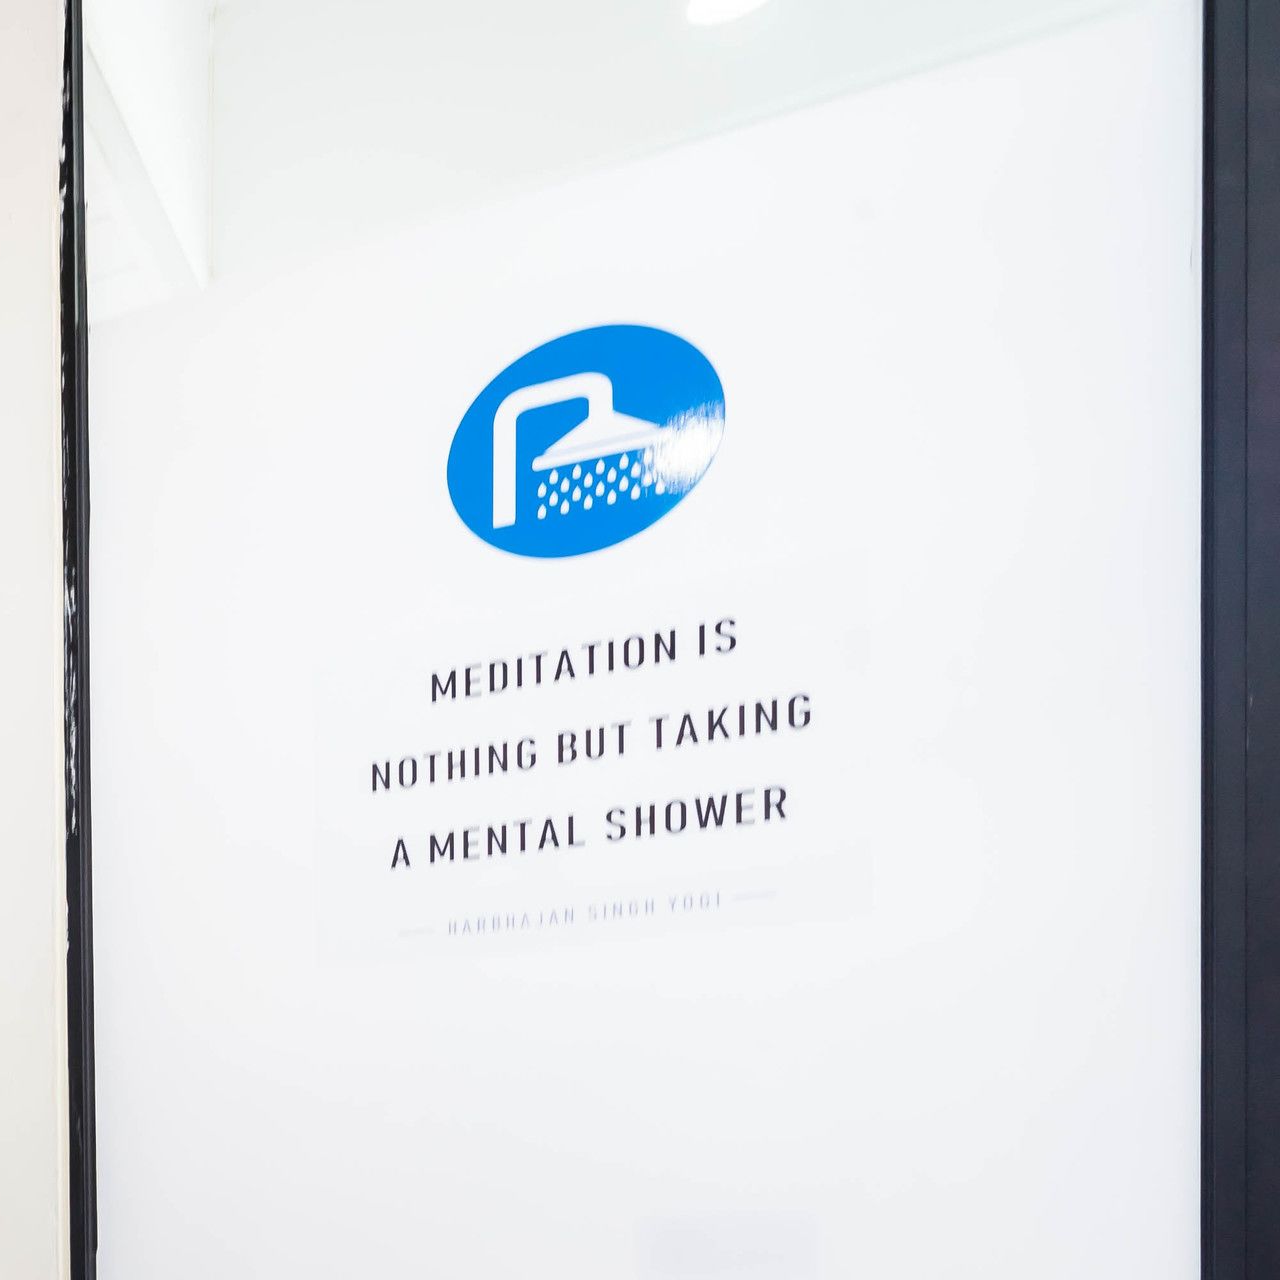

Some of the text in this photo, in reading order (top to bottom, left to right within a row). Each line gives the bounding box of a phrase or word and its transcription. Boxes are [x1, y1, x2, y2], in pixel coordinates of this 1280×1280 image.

[430, 617, 737, 704] MEDITATION IS
[371, 692, 813, 793] NOTHING BUT TAKING
[390, 785, 788, 870] A MENTAL SHOWER
[587, 896, 655, 922] SINGH
